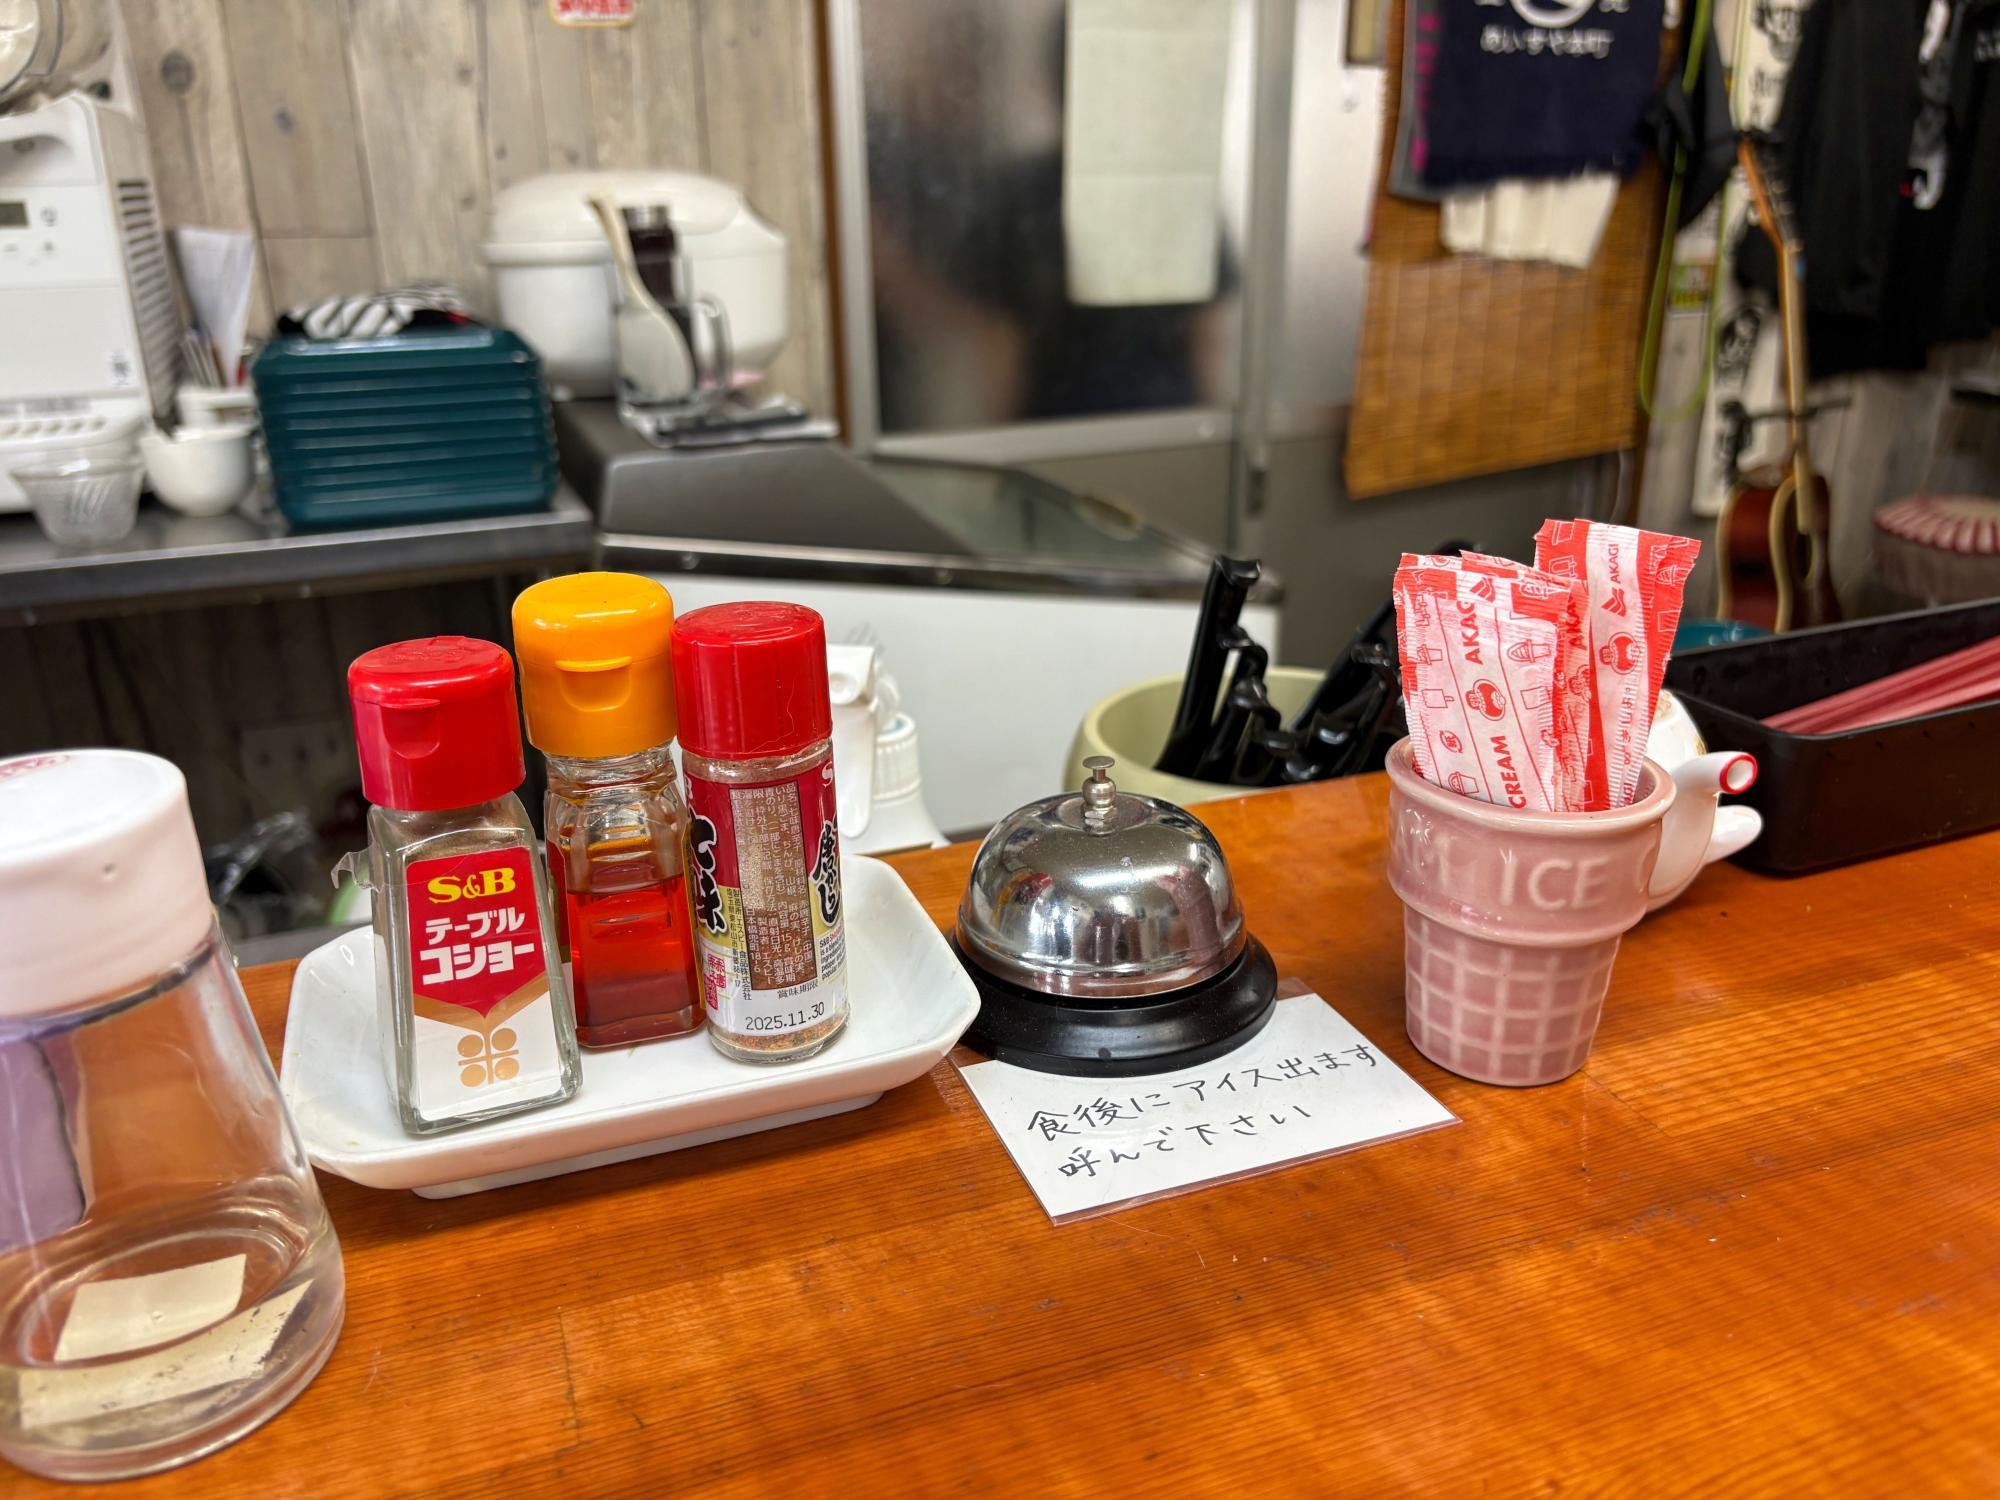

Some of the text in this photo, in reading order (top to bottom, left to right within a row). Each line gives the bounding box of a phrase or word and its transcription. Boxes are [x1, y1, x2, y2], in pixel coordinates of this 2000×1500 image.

[1611, 543, 1621, 584] AKAGI
[1459, 600, 1483, 665] AKAG
[1500, 735, 1527, 810] CREAM
[427, 867, 517, 904] S&B
[1500, 850, 1610, 911] ICE
[425, 906, 526, 945] テーブル
[419, 941, 535, 985] コショー
[777, 981, 818, 999] 賞味期限
[745, 1001, 825, 1031] 2025.11.30
[1026, 1043, 1381, 1141] 食後にアイス出ます
[1057, 1104, 1312, 1178] 呼んで下さい
